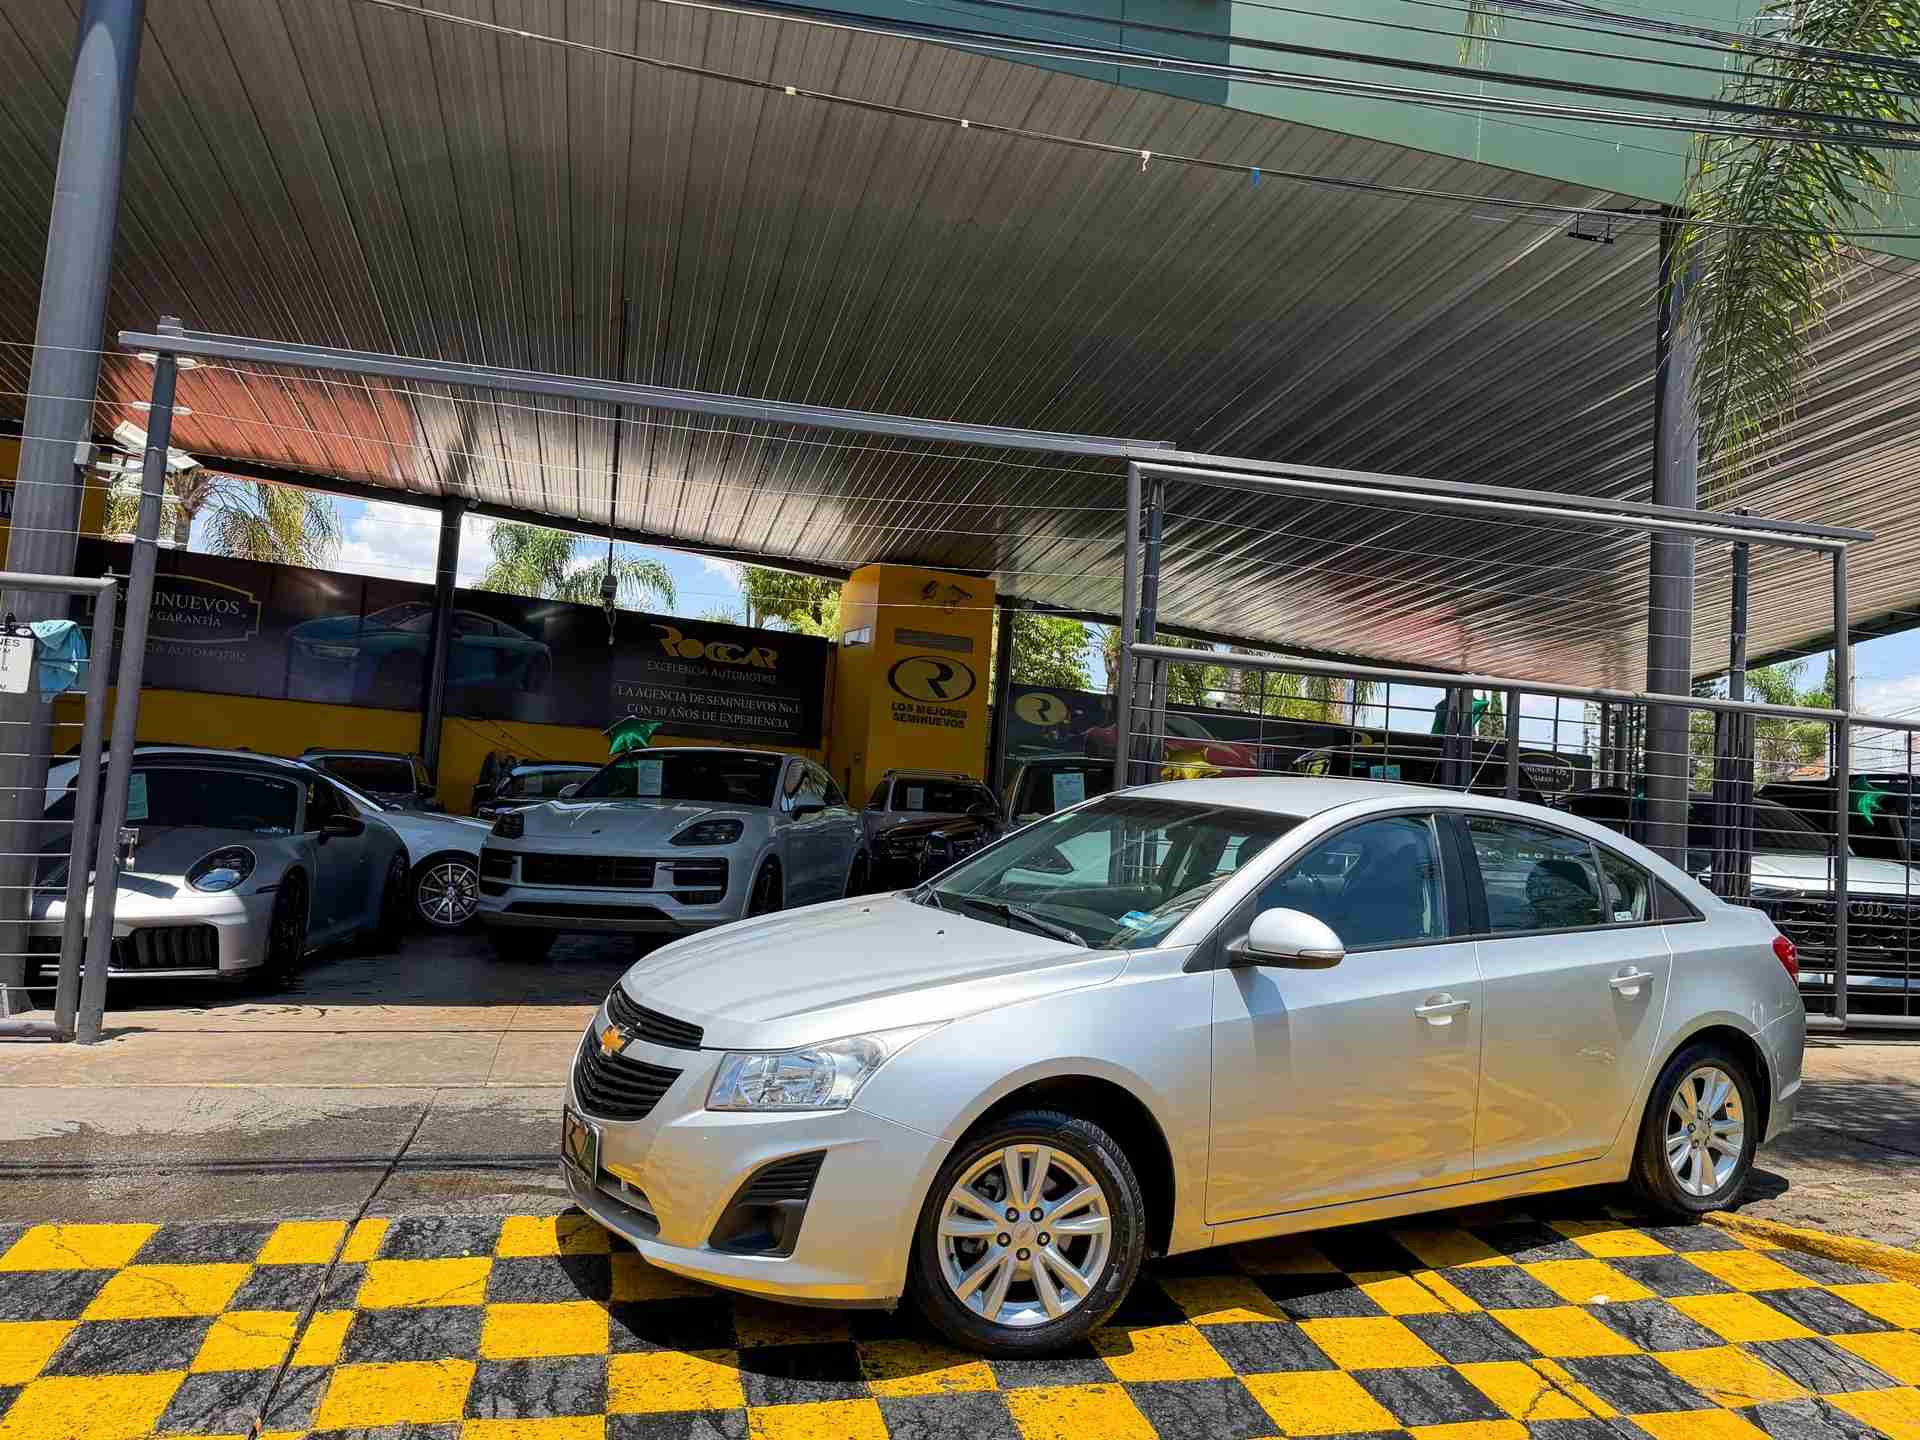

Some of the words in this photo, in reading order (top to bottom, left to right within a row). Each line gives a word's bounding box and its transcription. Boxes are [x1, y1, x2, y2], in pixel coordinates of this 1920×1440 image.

[649, 623, 779, 669] ROCCAR
[618, 686, 633, 697] LA
[633, 687, 687, 704] AGENCIA
[691, 692, 705, 704] DE
[706, 695, 777, 713] SEMINUEVOS
[891, 701, 913, 712] LOS
[916, 703, 968, 719] MEJORES
[626, 702, 652, 714] CON
[654, 706, 667, 717] 30
[669, 705, 700, 720] AÑOS
[702, 711, 717, 722] DE
[719, 711, 792, 729] EXPERIENCIA
[892, 711, 968, 729] SEMINUEVOS
